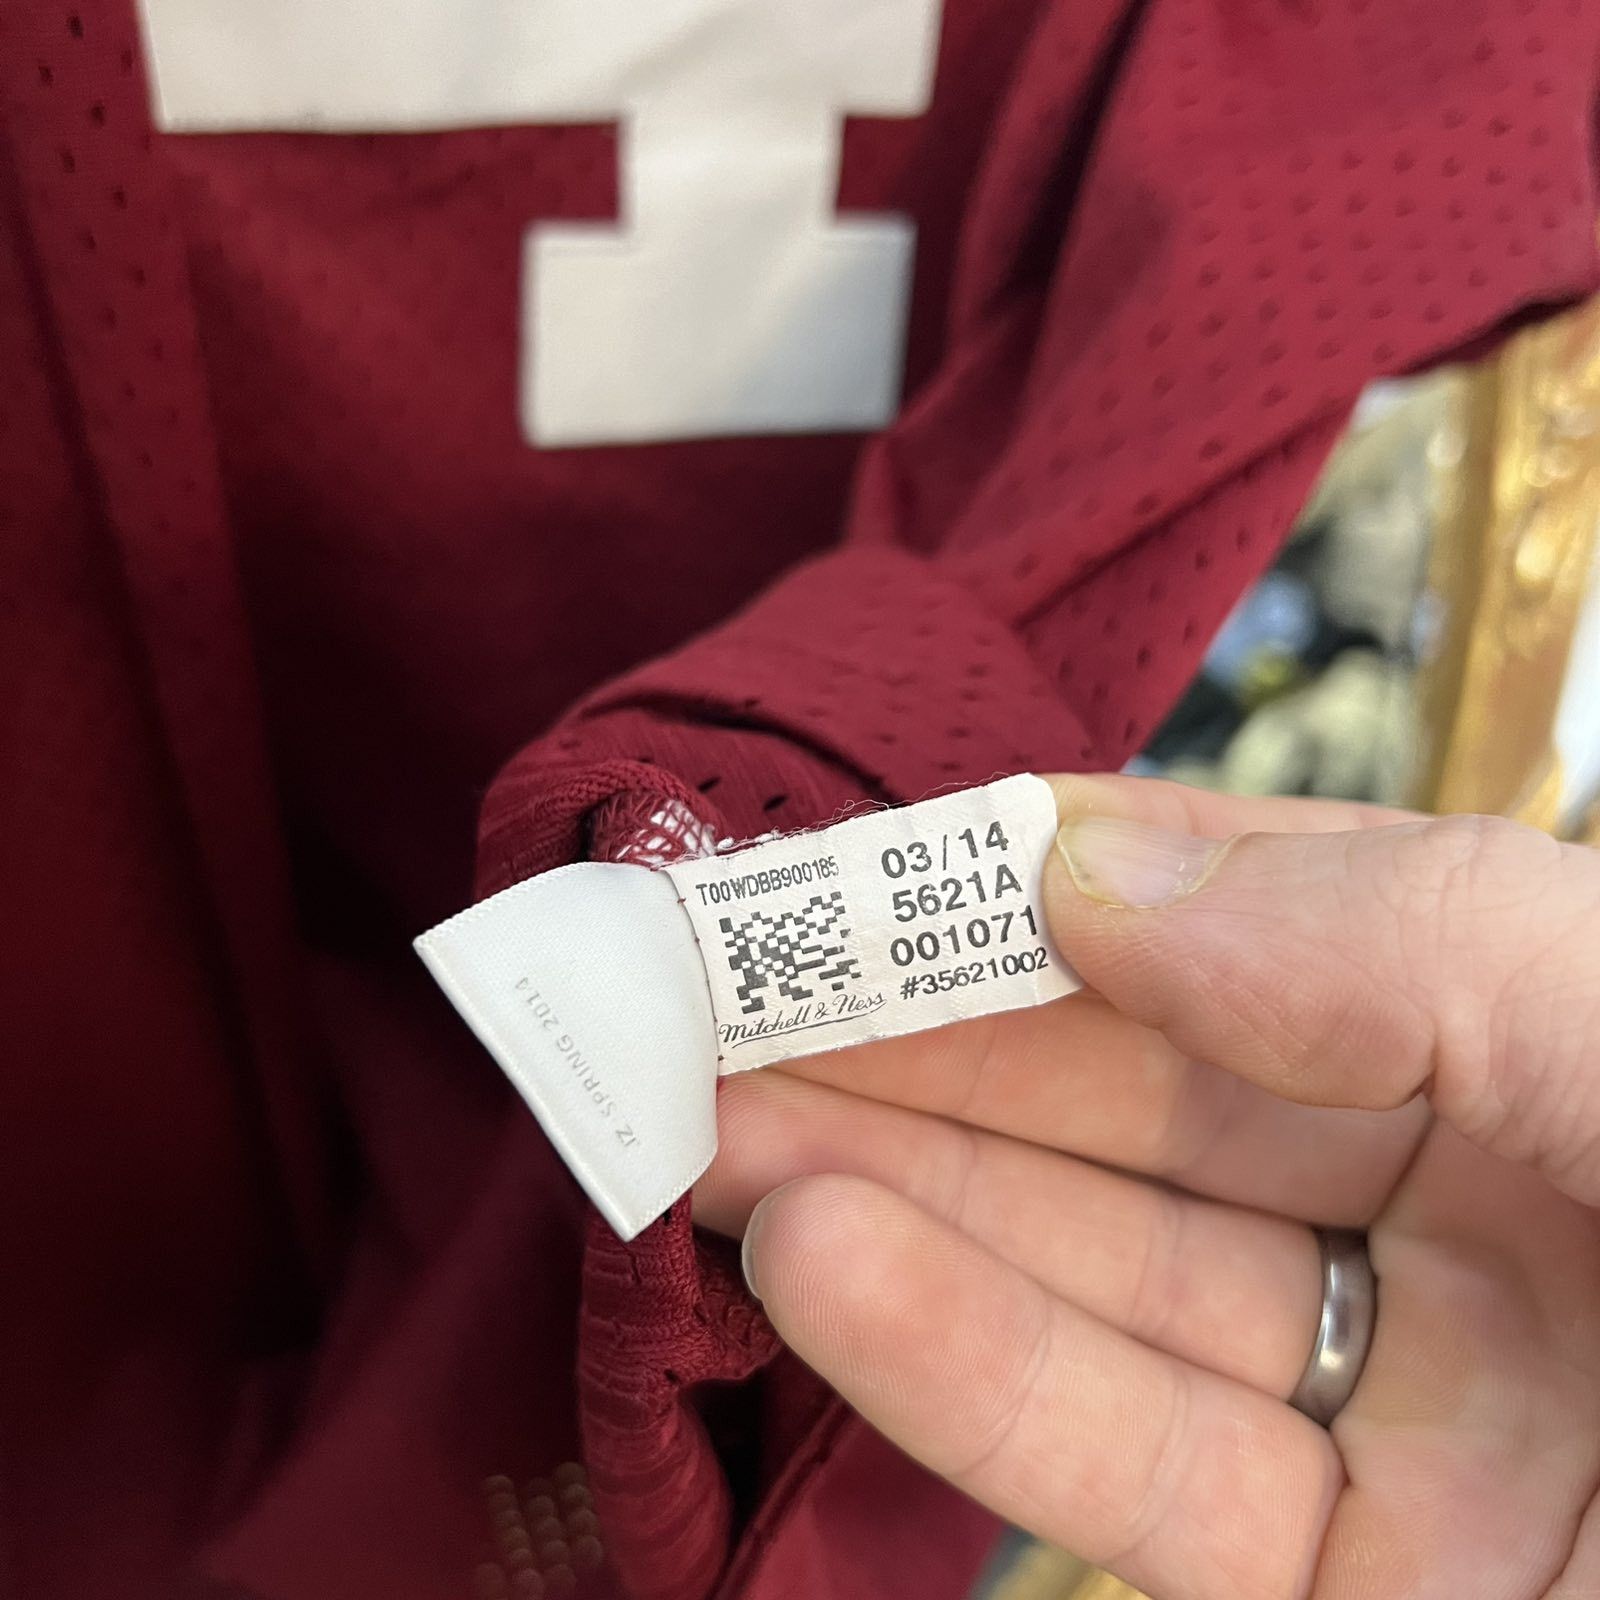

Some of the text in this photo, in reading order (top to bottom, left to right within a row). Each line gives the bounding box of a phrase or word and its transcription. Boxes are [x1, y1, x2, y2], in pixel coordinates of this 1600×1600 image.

[881, 820, 1010, 879] 03/14
[892, 863, 1023, 923] 5621A
[890, 904, 1039, 967] 001071
[900, 947, 1049, 1000] #35621002
[718, 990, 889, 1044] Mitchell & Ness
[556, 1033, 617, 1118] SPRING
